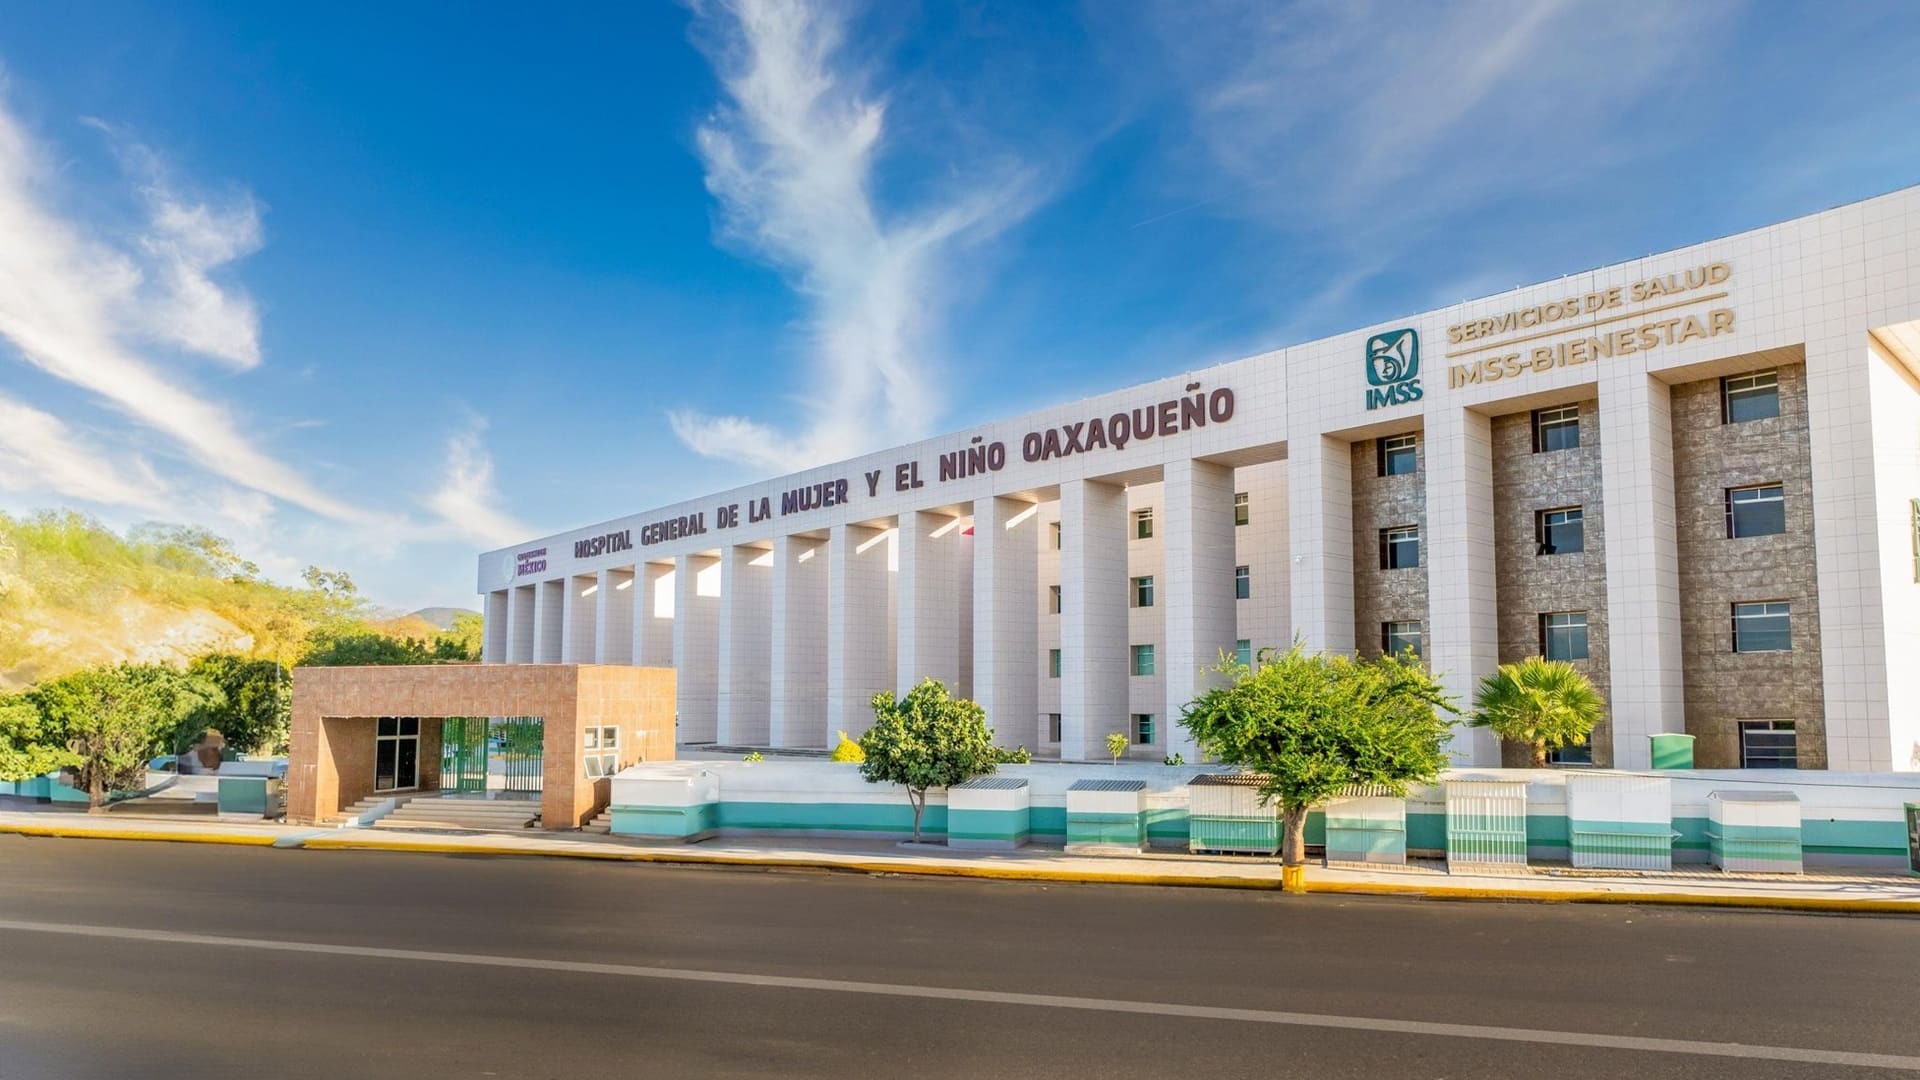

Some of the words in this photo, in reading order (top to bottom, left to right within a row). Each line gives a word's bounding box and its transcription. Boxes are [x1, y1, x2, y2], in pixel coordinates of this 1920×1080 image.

[1447, 298, 1579, 344] SERVICIOS
[1583, 286, 1622, 314] DE
[1630, 262, 1731, 302] SALUD
[1447, 308, 1735, 390] IMSS-BIENESTAR
[1366, 379, 1423, 410] IMSS
[574, 530, 633, 558] HOSPITAL
[641, 512, 707, 546] GENERAL
[717, 504, 739, 529] DE
[749, 497, 771, 523] LA
[781, 478, 849, 516] MUJER
[864, 470, 881, 497] Y
[895, 461, 924, 492] EL
[939, 436, 1005, 482] NIÑO
[1022, 382, 1235, 462] OAXAQUEÑO
[518, 559, 547, 576] MÉXICO
